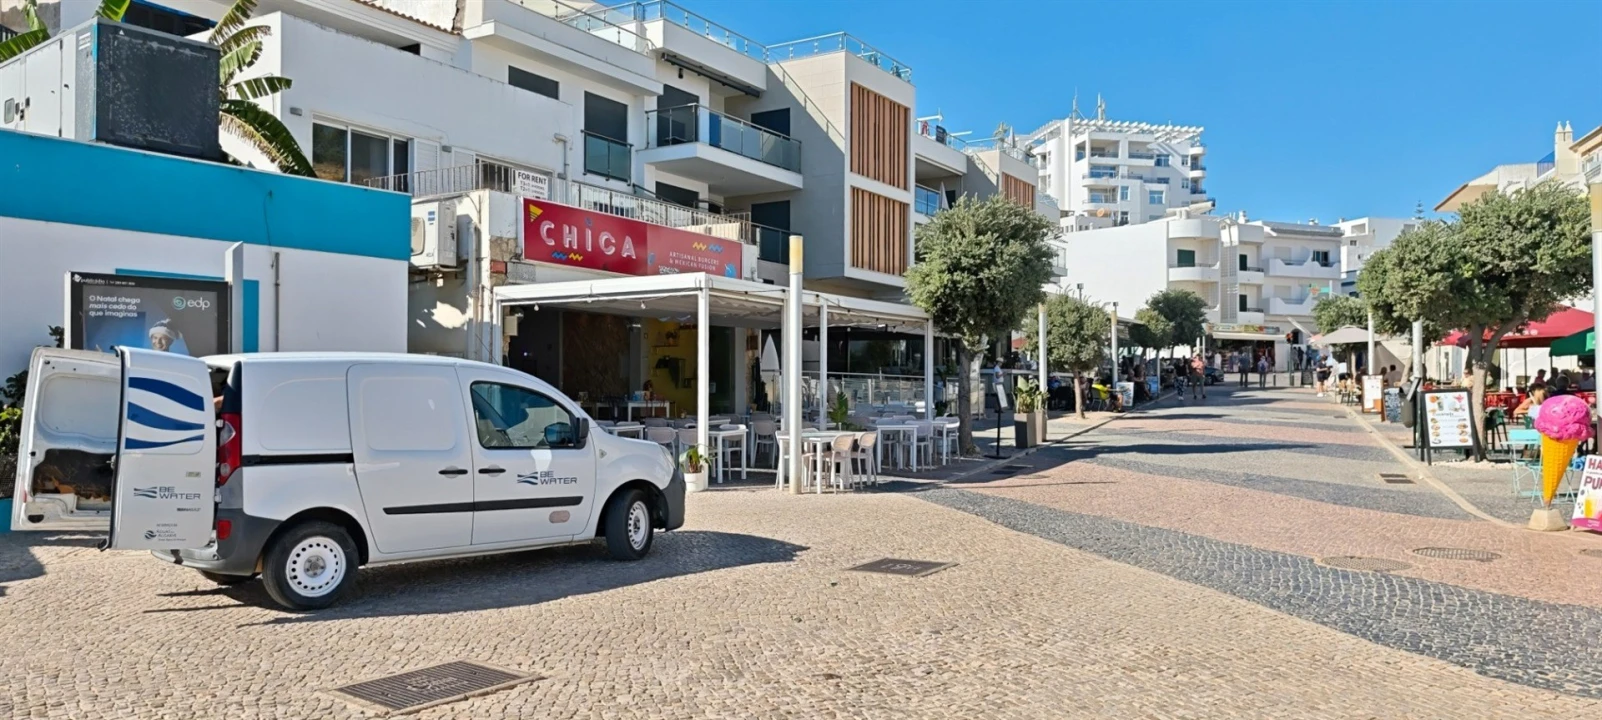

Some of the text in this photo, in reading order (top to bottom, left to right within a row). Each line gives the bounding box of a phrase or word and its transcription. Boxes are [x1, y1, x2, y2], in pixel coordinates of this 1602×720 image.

[517, 171, 547, 185] FOR RENT
[540, 217, 636, 259] CHICA
[669, 251, 719, 265] ARTISANAL BURGERS
[674, 258, 697, 267] MEXICAN
[698, 262, 716, 271] FUSION
[89, 294, 96, 302] O
[118, 296, 141, 304] chega
[187, 297, 210, 310] edp
[105, 310, 138, 318] imaginas
[540, 477, 577, 485] WATER
